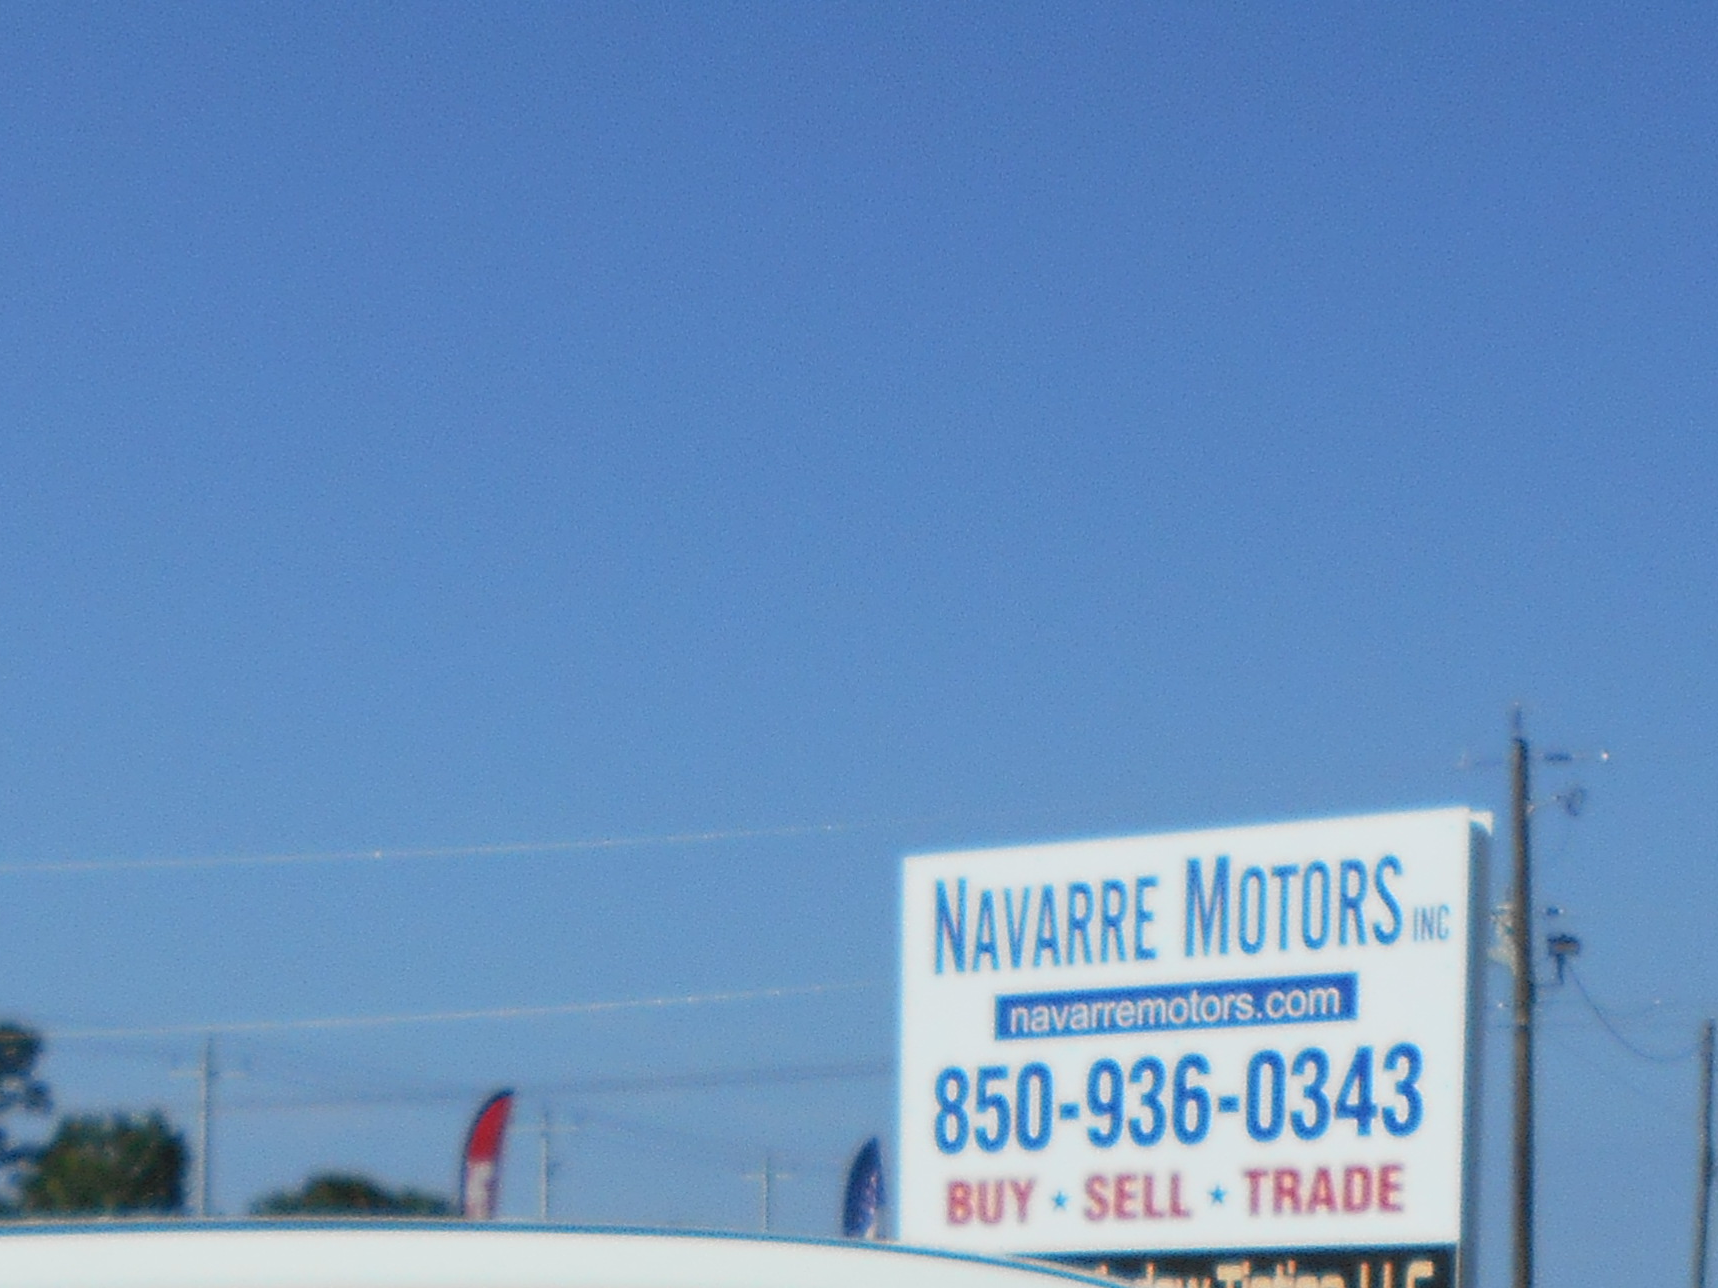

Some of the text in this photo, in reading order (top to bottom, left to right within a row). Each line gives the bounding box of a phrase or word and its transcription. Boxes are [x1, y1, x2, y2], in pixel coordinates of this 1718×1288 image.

[1413, 903, 1452, 943] INC
[1009, 982, 1341, 1035] navarremotors.com
[933, 1040, 1424, 1156] 850-936-0343
[945, 1163, 1405, 1226] BUY SELL TRADE
